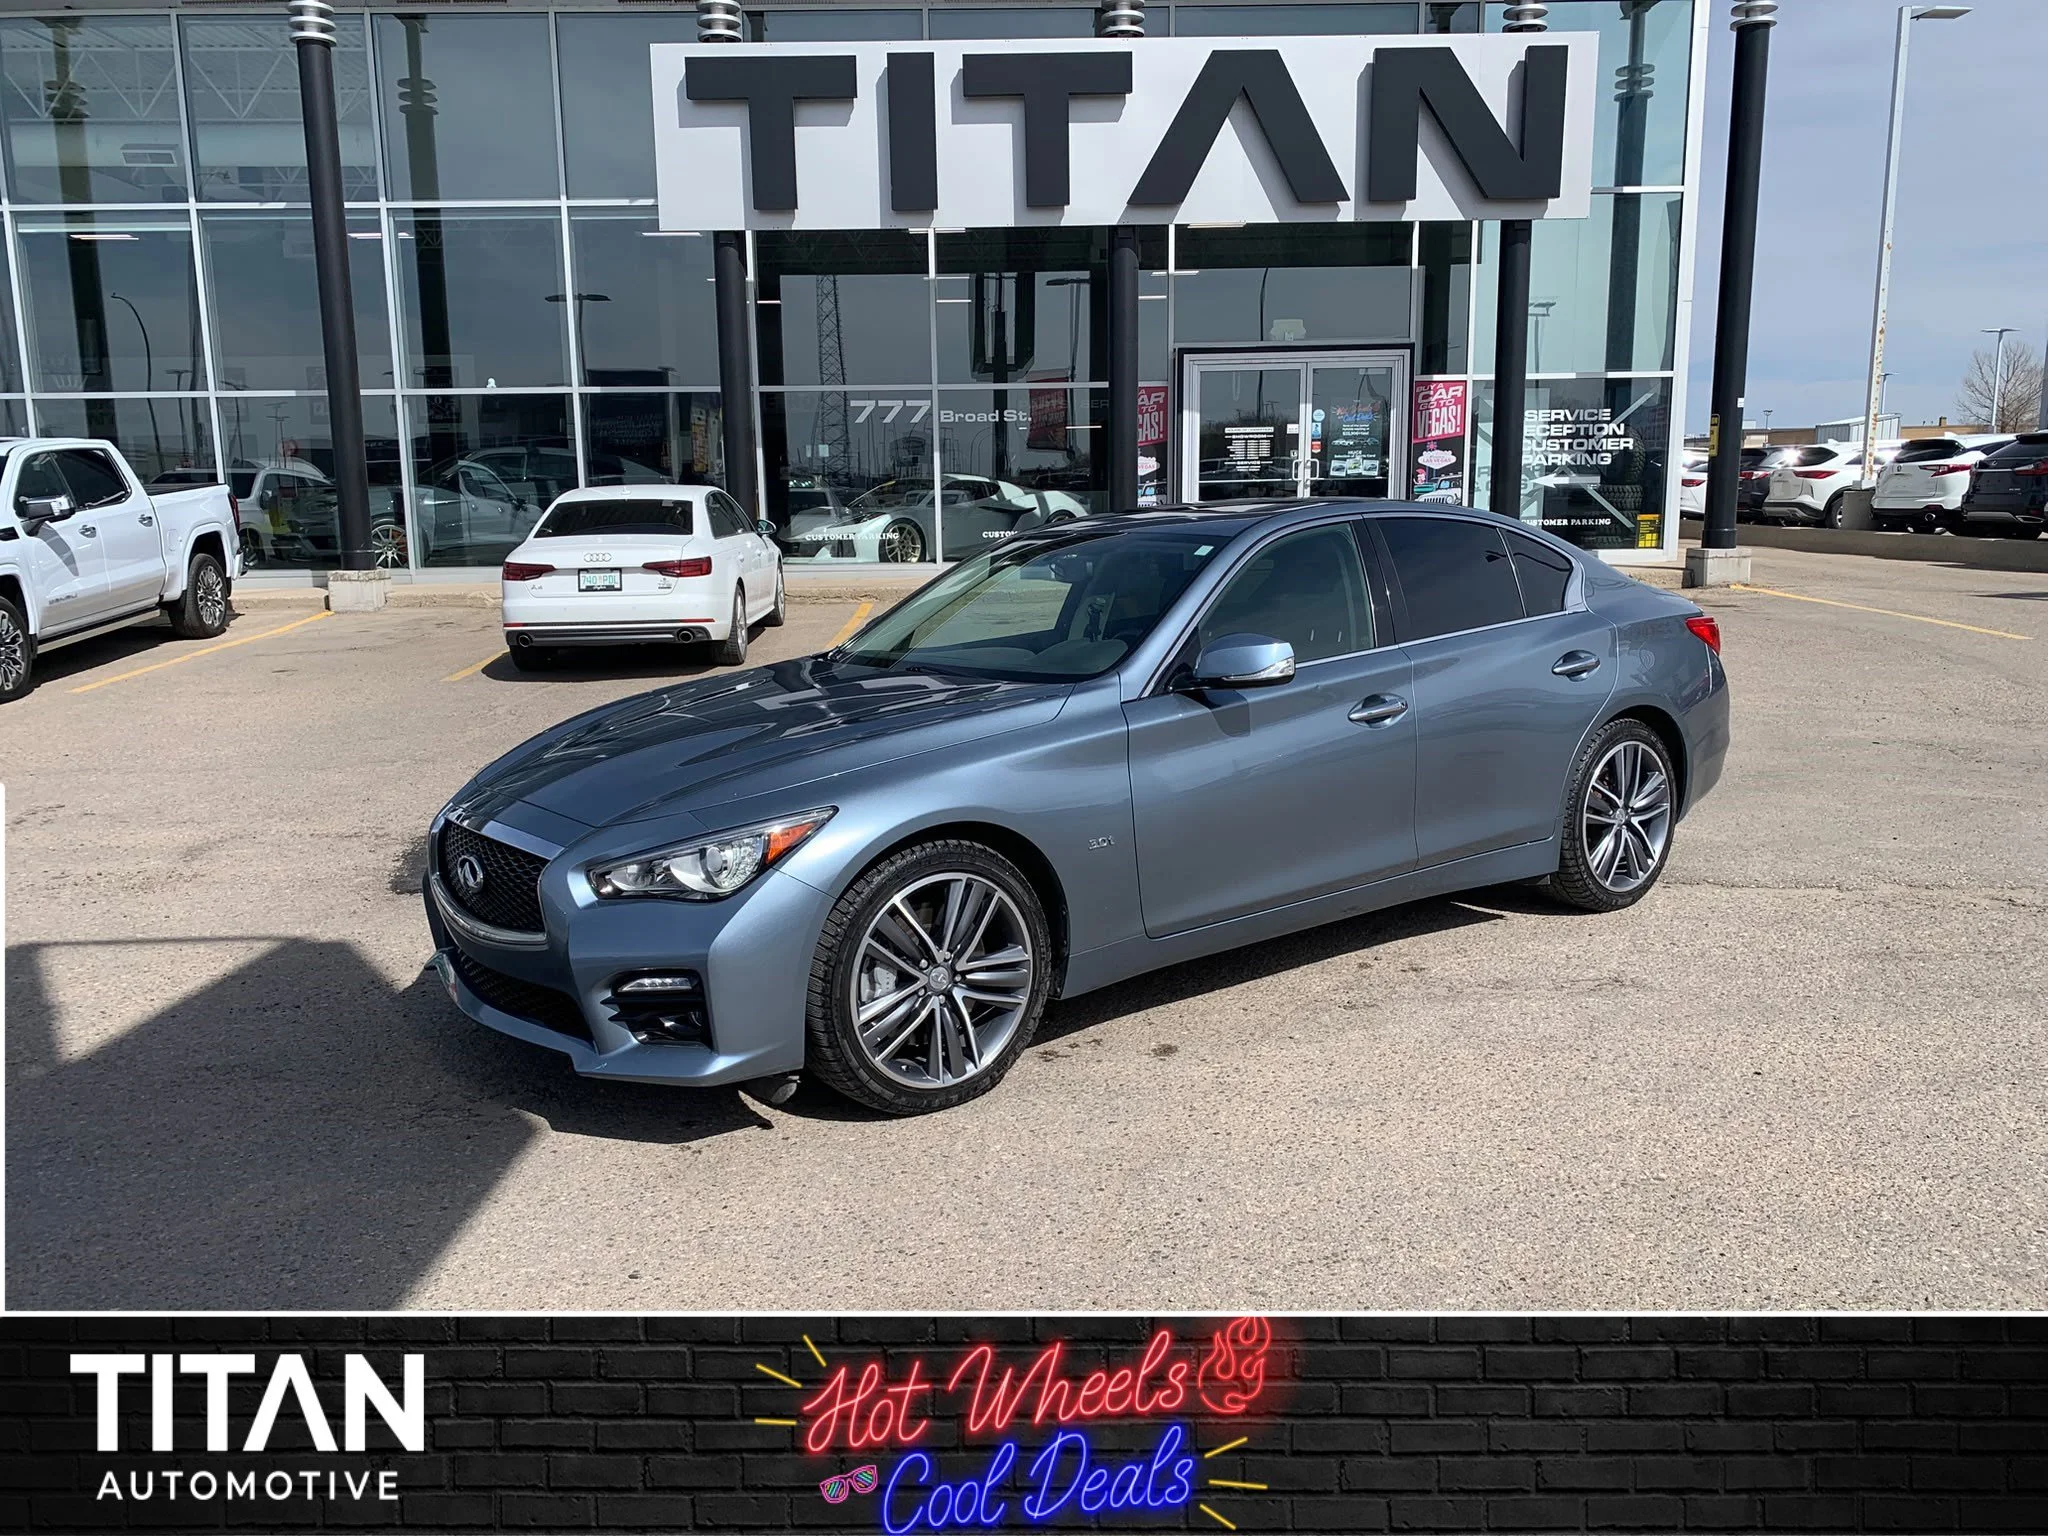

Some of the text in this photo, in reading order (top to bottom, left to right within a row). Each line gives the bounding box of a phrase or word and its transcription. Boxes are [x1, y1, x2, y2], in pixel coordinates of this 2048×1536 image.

[685, 46, 1569, 215] TITAN
[1416, 383, 1436, 392] BUY
[1138, 392, 1165, 406] AR
[1418, 386, 1463, 403] CAR
[1141, 405, 1157, 413] TO
[1420, 399, 1455, 410] GO TO
[850, 400, 1032, 423] 777 Broad St.
[1524, 409, 1611, 422] SERVICE
[1418, 405, 1461, 438] VEGAS!
[1523, 423, 1625, 436] ECEPTION
[1522, 453, 1612, 466] PARKING
[1571, 518, 1612, 526] PARKING
[805, 533, 854, 541] CUSTOMER
[982, 530, 1018, 538] CUSTO
